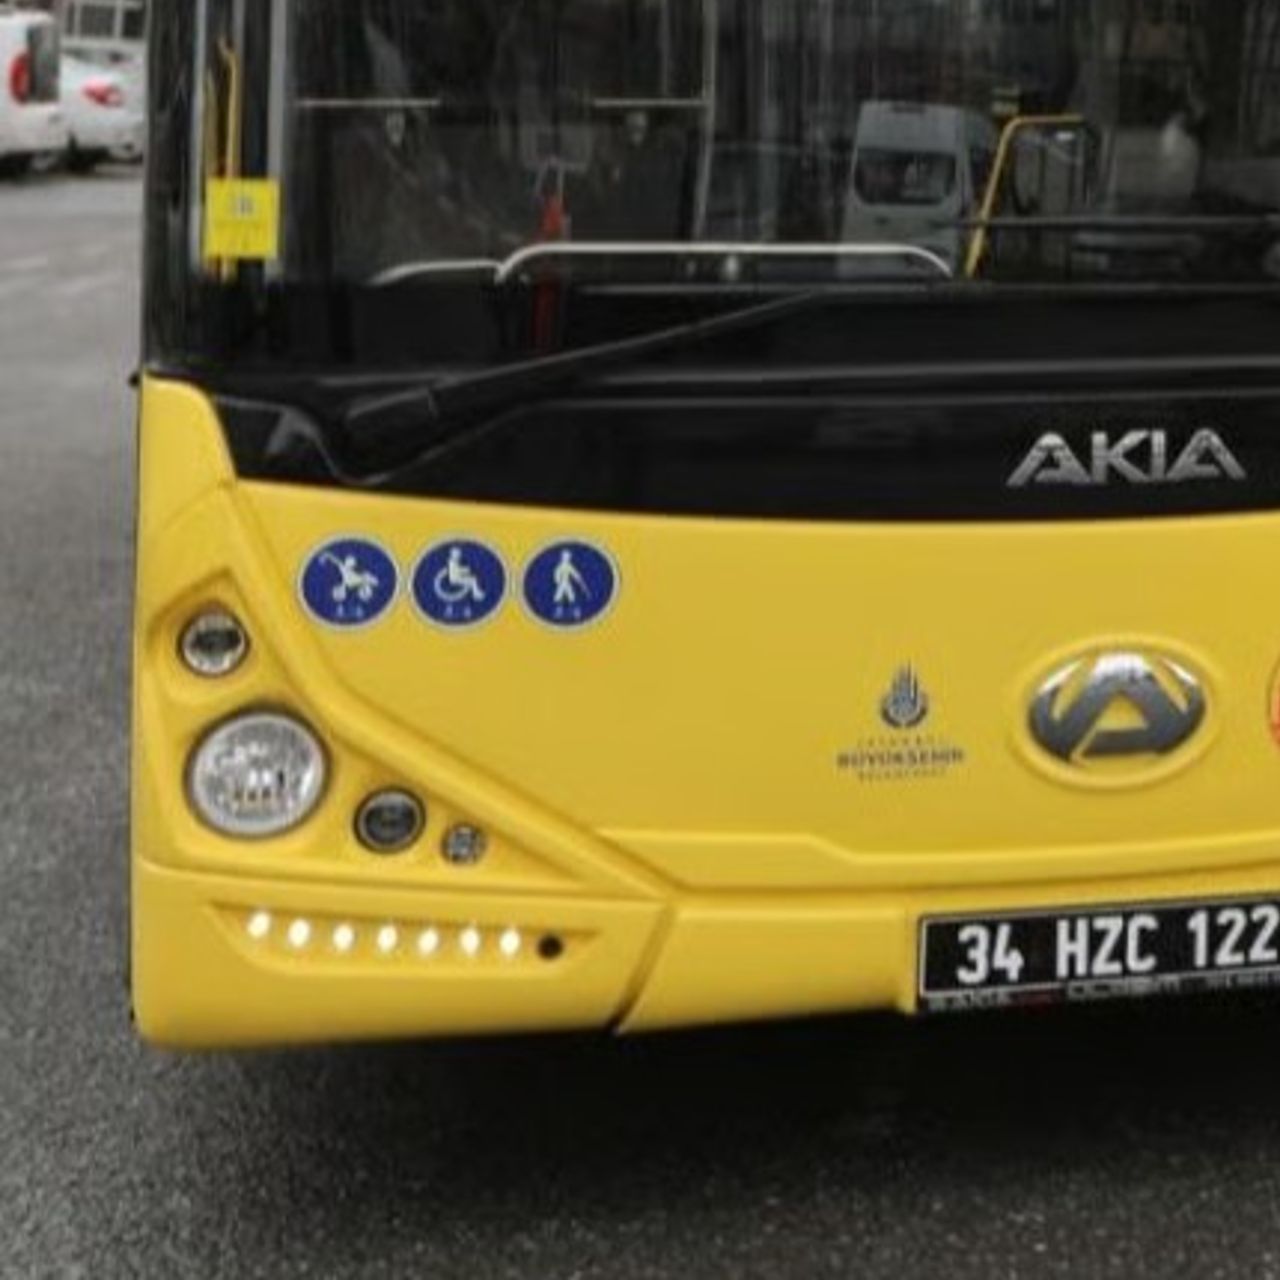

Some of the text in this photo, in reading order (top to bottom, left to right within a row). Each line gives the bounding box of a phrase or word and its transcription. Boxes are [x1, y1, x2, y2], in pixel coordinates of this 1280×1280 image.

[1006, 427, 1247, 487] AKIA
[956, 922, 1025, 985] 34
[1055, 913, 1160, 979] HZC
